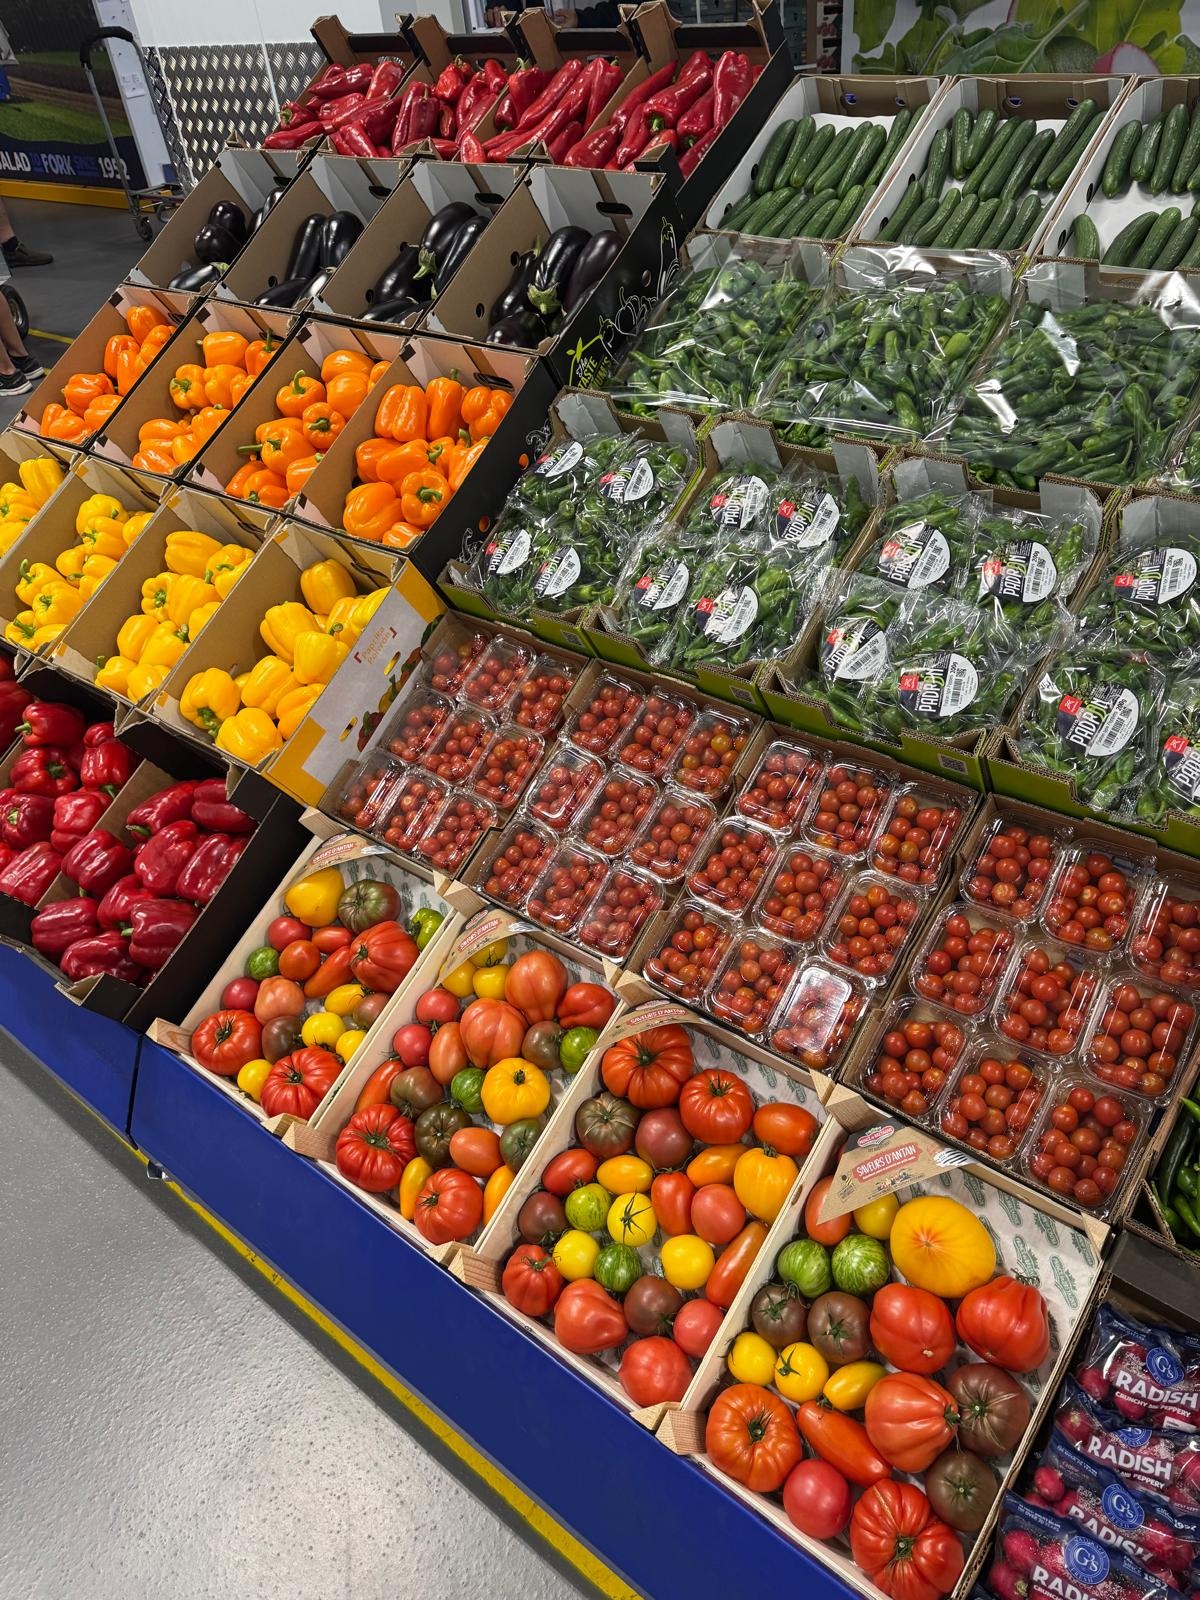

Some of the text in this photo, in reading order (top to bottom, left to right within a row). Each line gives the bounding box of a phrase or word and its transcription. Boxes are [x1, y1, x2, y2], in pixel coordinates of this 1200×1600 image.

[0, 150, 31, 172] ALAD
[41, 153, 77, 176] FORK
[98, 156, 131, 180] 1952
[949, 661, 959, 674] 200g
[1116, 698, 1128, 712] 200g
[856, 1155, 886, 1177] SAVEURS
[884, 1144, 917, 1166] D'ANTAN
[1115, 1370, 1199, 1409] RADISH
[1115, 1391, 1148, 1407] CRUNCHY
[1159, 1404, 1192, 1418] PEPPERY
[1088, 1435, 1172, 1480] RADISH
[1133, 1472, 1165, 1489] PEPPERY
[1075, 1547, 1098, 1572] G's
[1033, 1564, 1100, 1600] RADI
[1143, 1573, 1168, 1590] 1952
